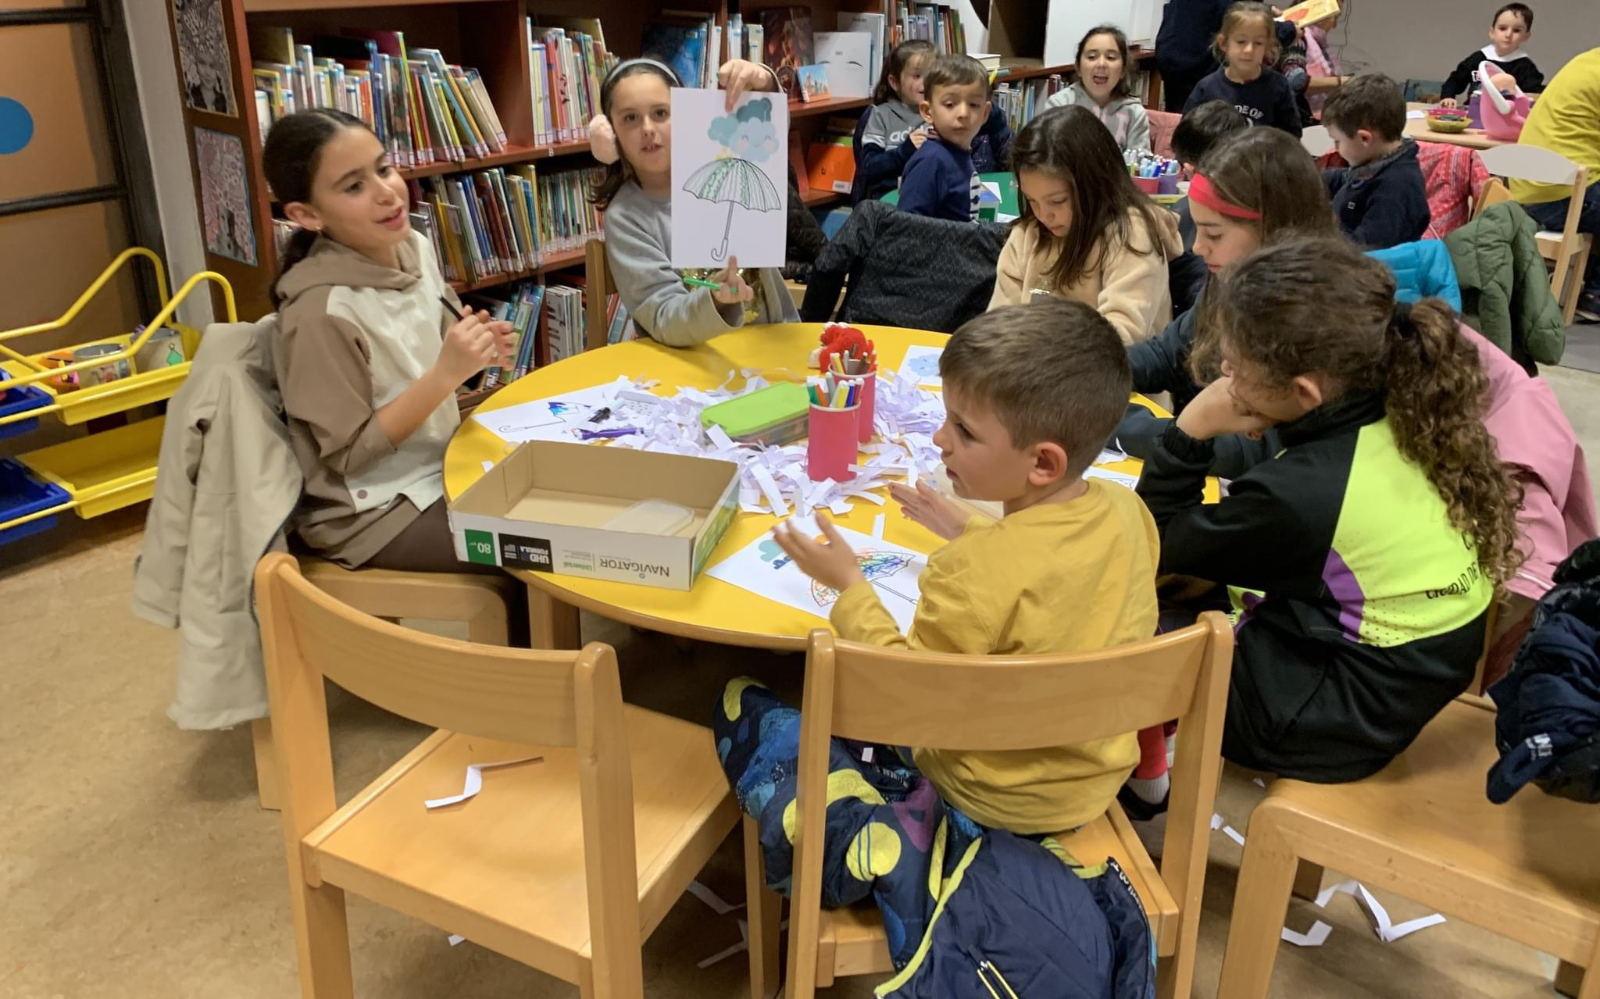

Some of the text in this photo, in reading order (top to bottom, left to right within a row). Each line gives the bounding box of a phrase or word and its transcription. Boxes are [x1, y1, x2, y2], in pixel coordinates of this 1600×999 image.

[477, 542, 491, 554] 80
[519, 545, 549, 555] FORMULA
[529, 553, 550, 564] UHD
[599, 558, 670, 578] NAVIGATOR
